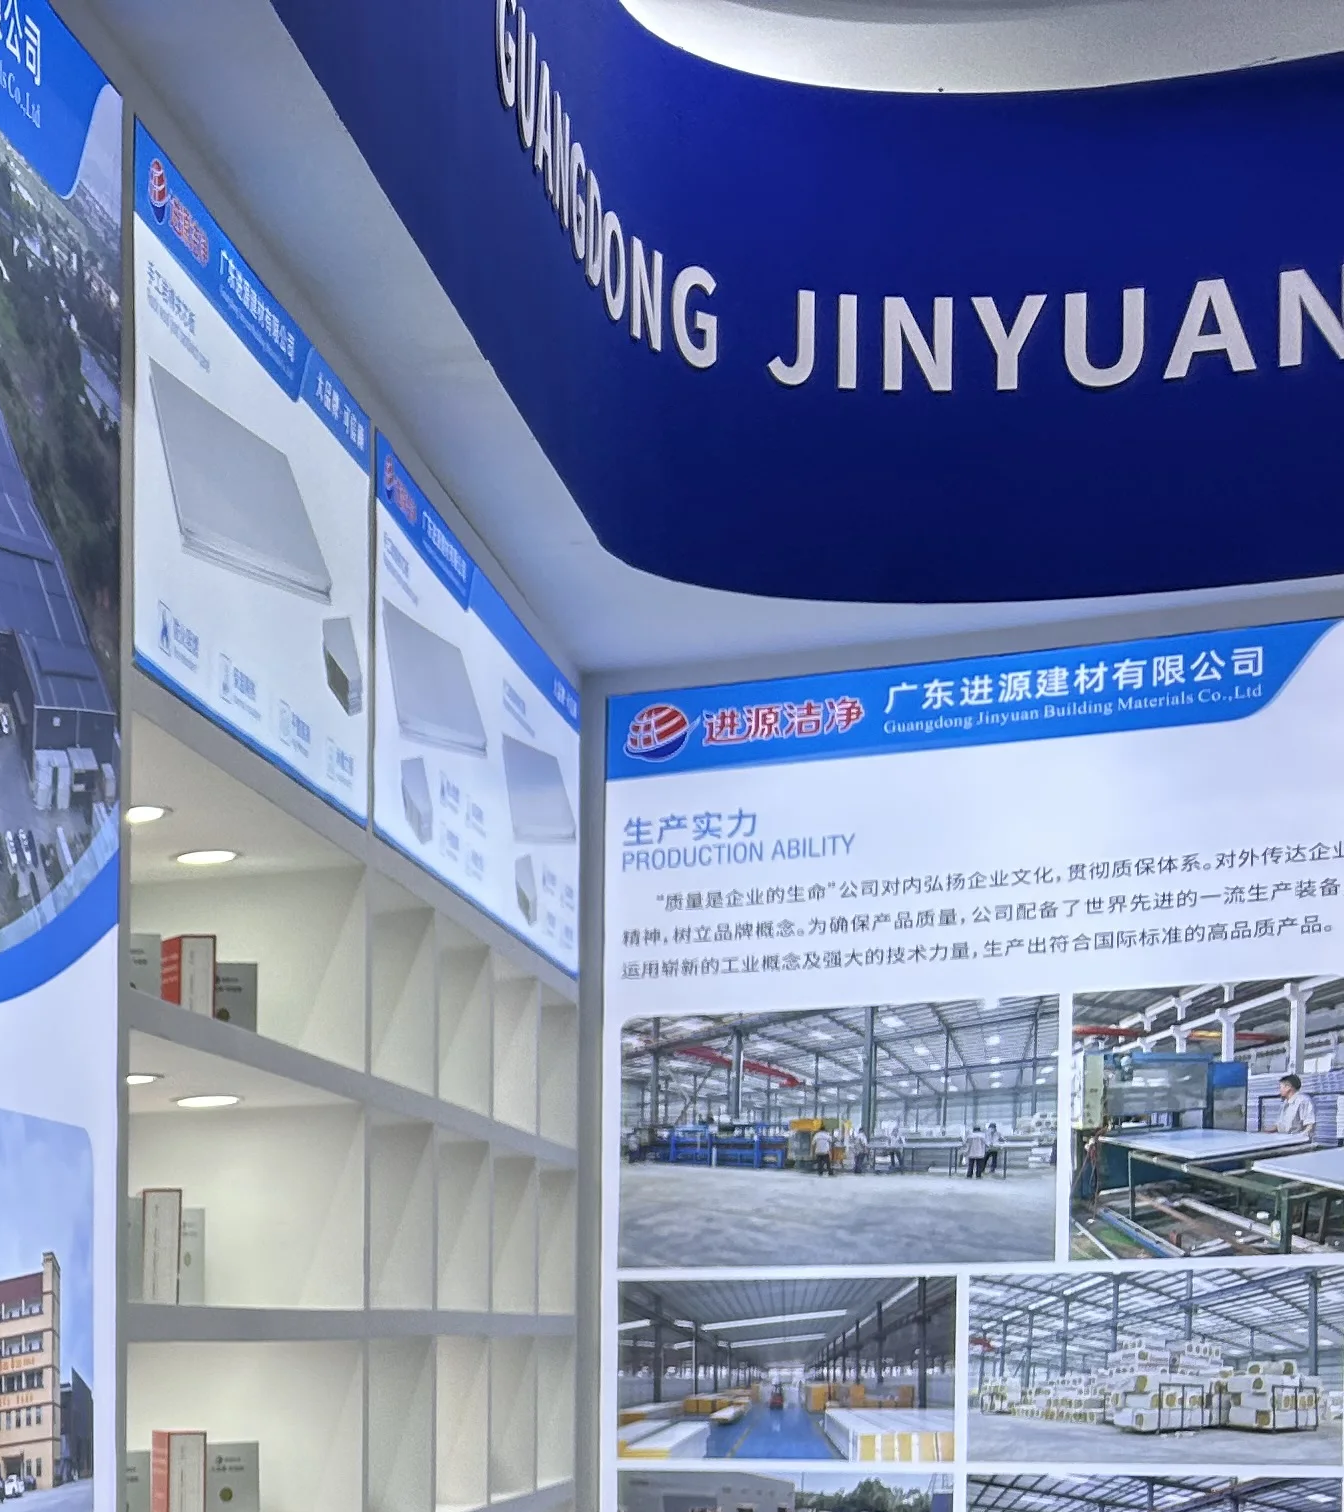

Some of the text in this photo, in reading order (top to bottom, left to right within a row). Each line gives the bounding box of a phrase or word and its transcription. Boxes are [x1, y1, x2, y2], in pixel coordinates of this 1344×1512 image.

[494, 0, 1344, 392] GUANGDONG JINYUAN
[701, 645, 1265, 747] 进源洁净 广东进源建材有限公司
[883, 713, 974, 735] Guangdong
[975, 707, 1040, 728] Jinyuan
[1043, 698, 1114, 721] Building
[1117, 689, 1195, 713] Materials
[622, 806, 758, 848] 生产实力
[621, 832, 857, 873] PRODUCTION ABILITY
